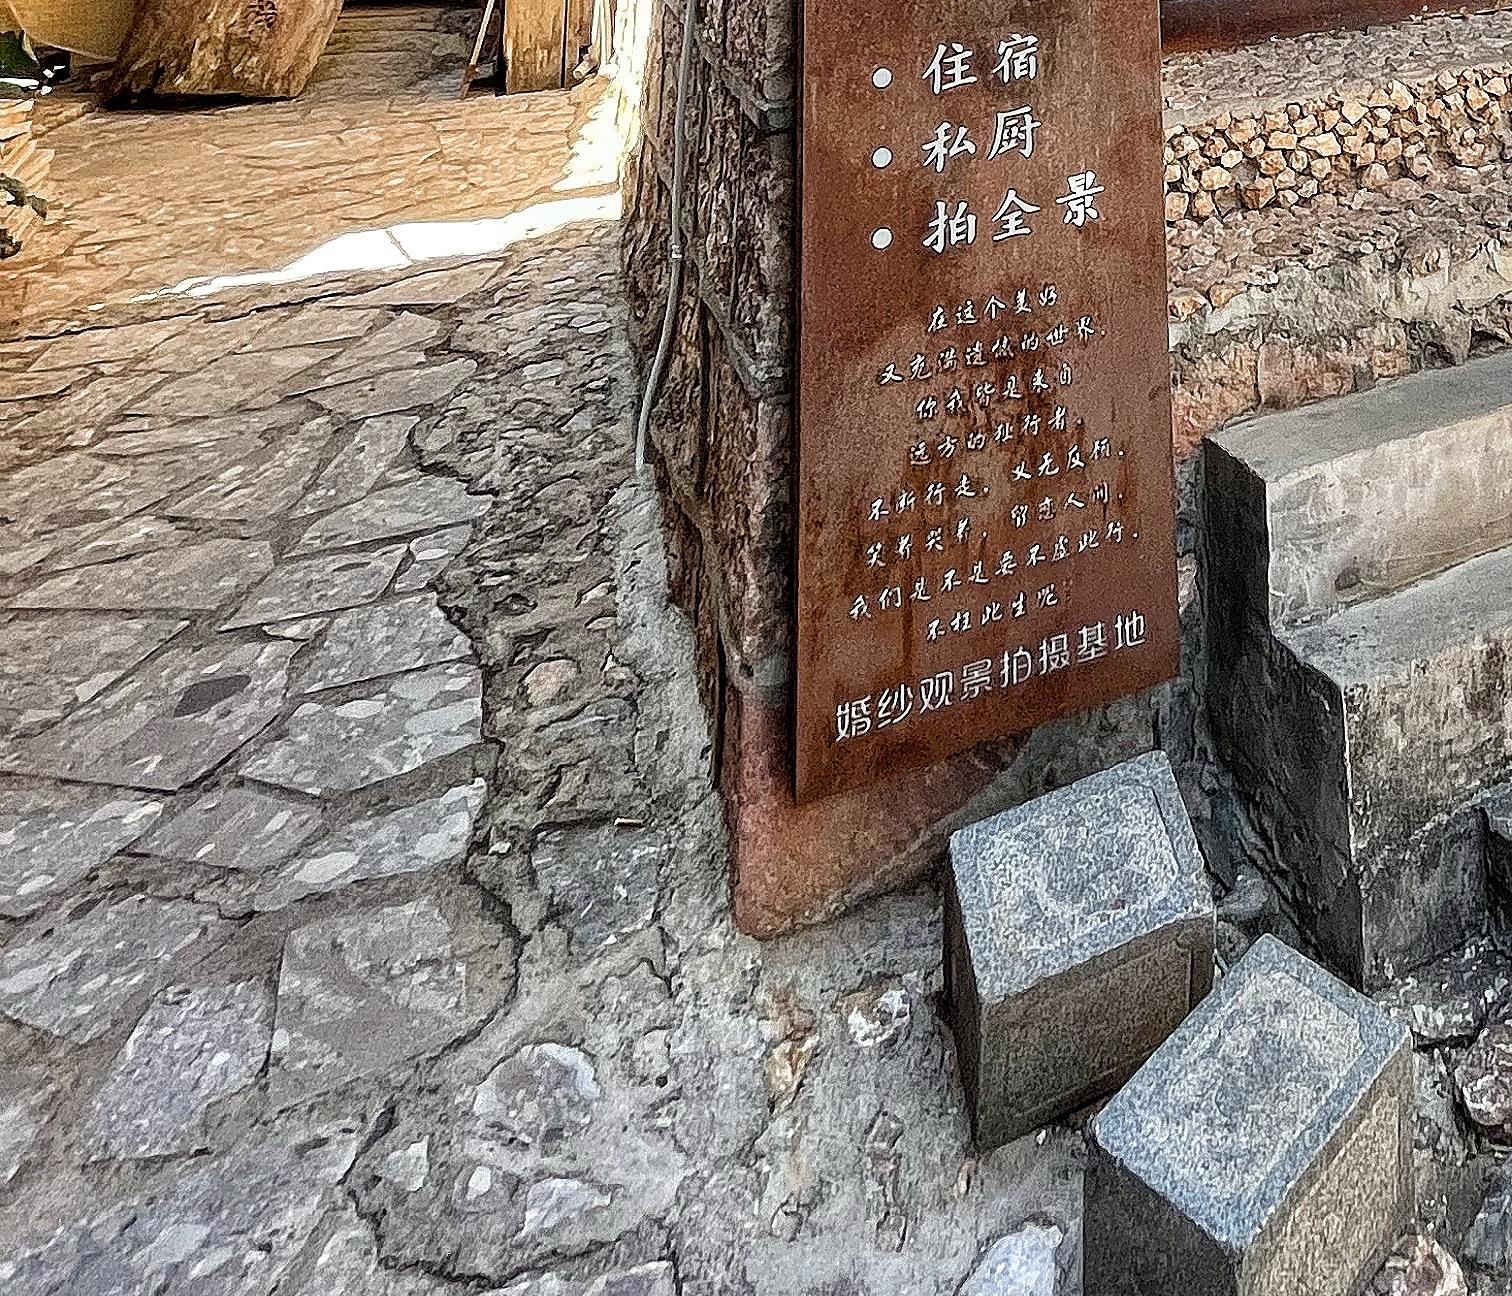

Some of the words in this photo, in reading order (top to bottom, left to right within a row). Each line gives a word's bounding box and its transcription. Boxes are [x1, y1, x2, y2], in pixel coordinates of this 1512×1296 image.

[922, 33, 1041, 95] 住宿
[922, 104, 1043, 173] 私厨
[922, 170, 1105, 254] 拍全景
[834, 610, 1148, 744] 婚纱观景拍摄基地
